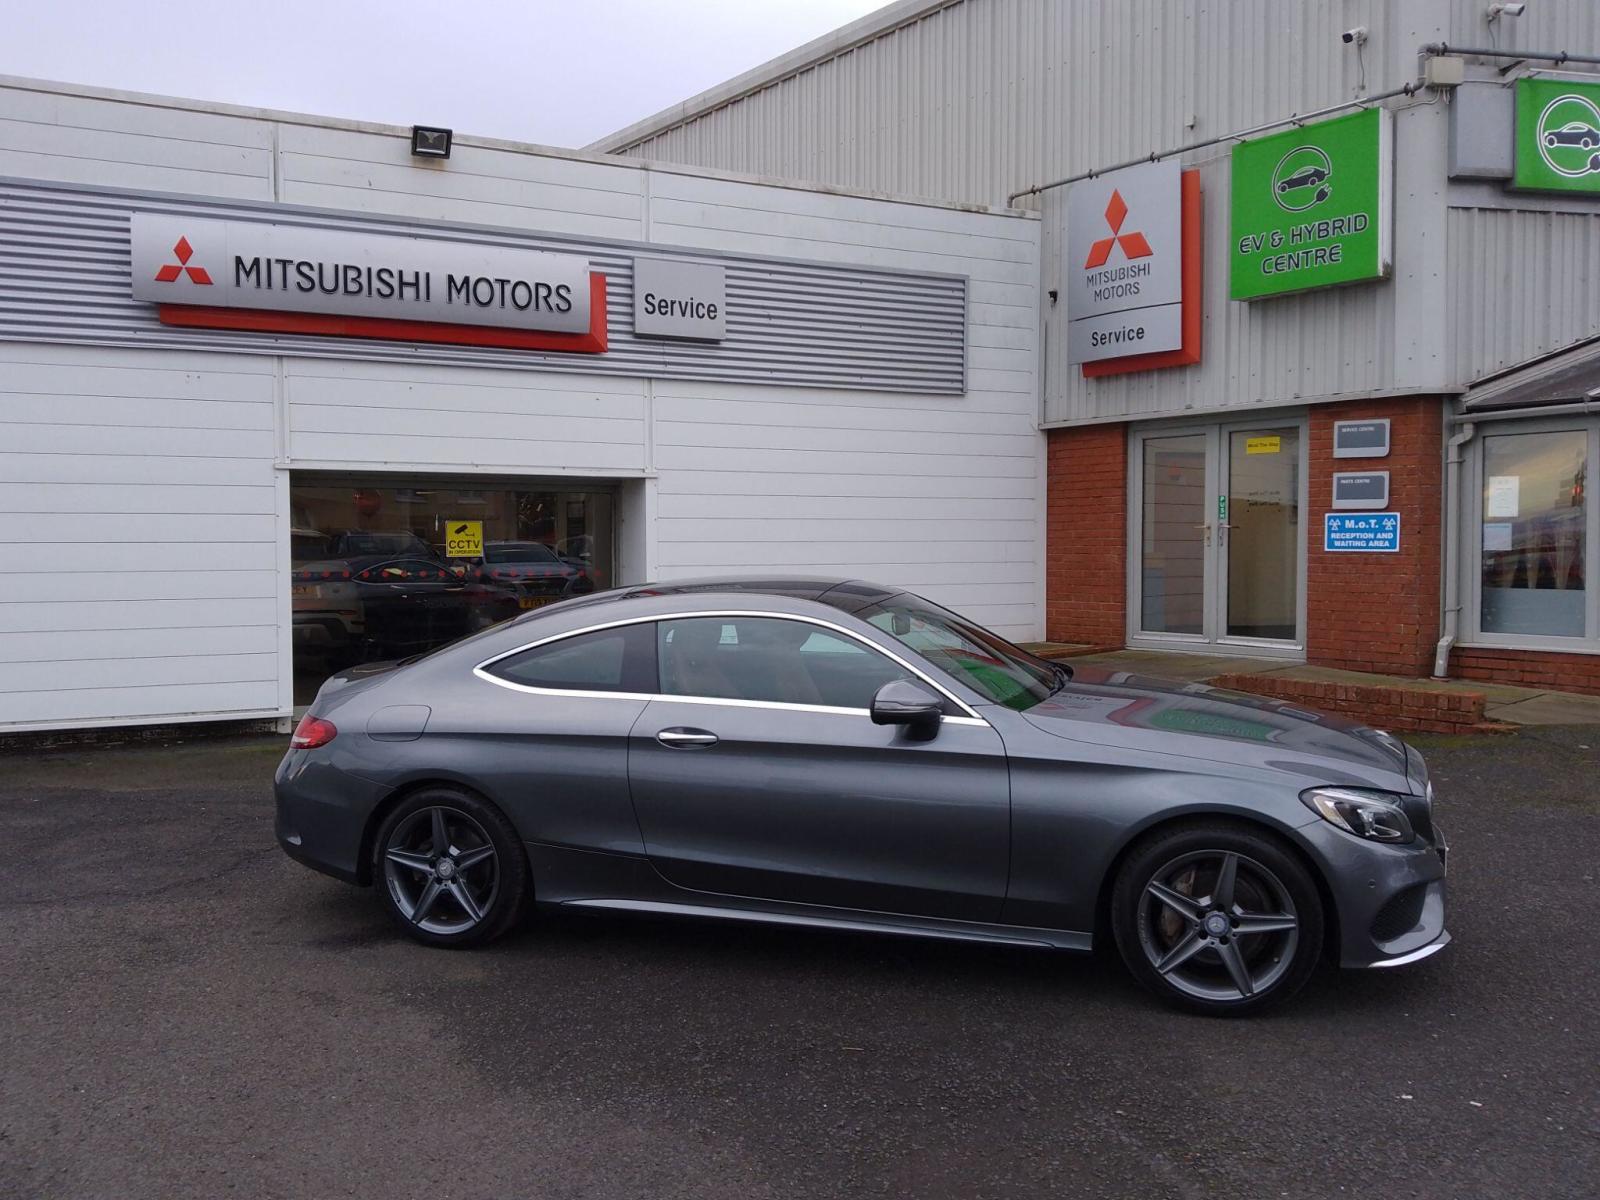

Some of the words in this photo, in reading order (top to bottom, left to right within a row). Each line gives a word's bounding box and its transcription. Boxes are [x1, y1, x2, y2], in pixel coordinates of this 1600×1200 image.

[1239, 232, 1266, 254] EV
[1270, 230, 1285, 248] &
[1290, 212, 1369, 245] HYBRID
[1262, 244, 1342, 276] CENTRE
[234, 255, 431, 302] MITSUBISHI
[447, 273, 572, 313] MOTORS
[1086, 262, 1151, 288] MITSUBISHI
[1094, 281, 1140, 302] MOTORS
[643, 292, 718, 321] Service
[1091, 325, 1145, 347] Service
[448, 540, 480, 549] CCTV
